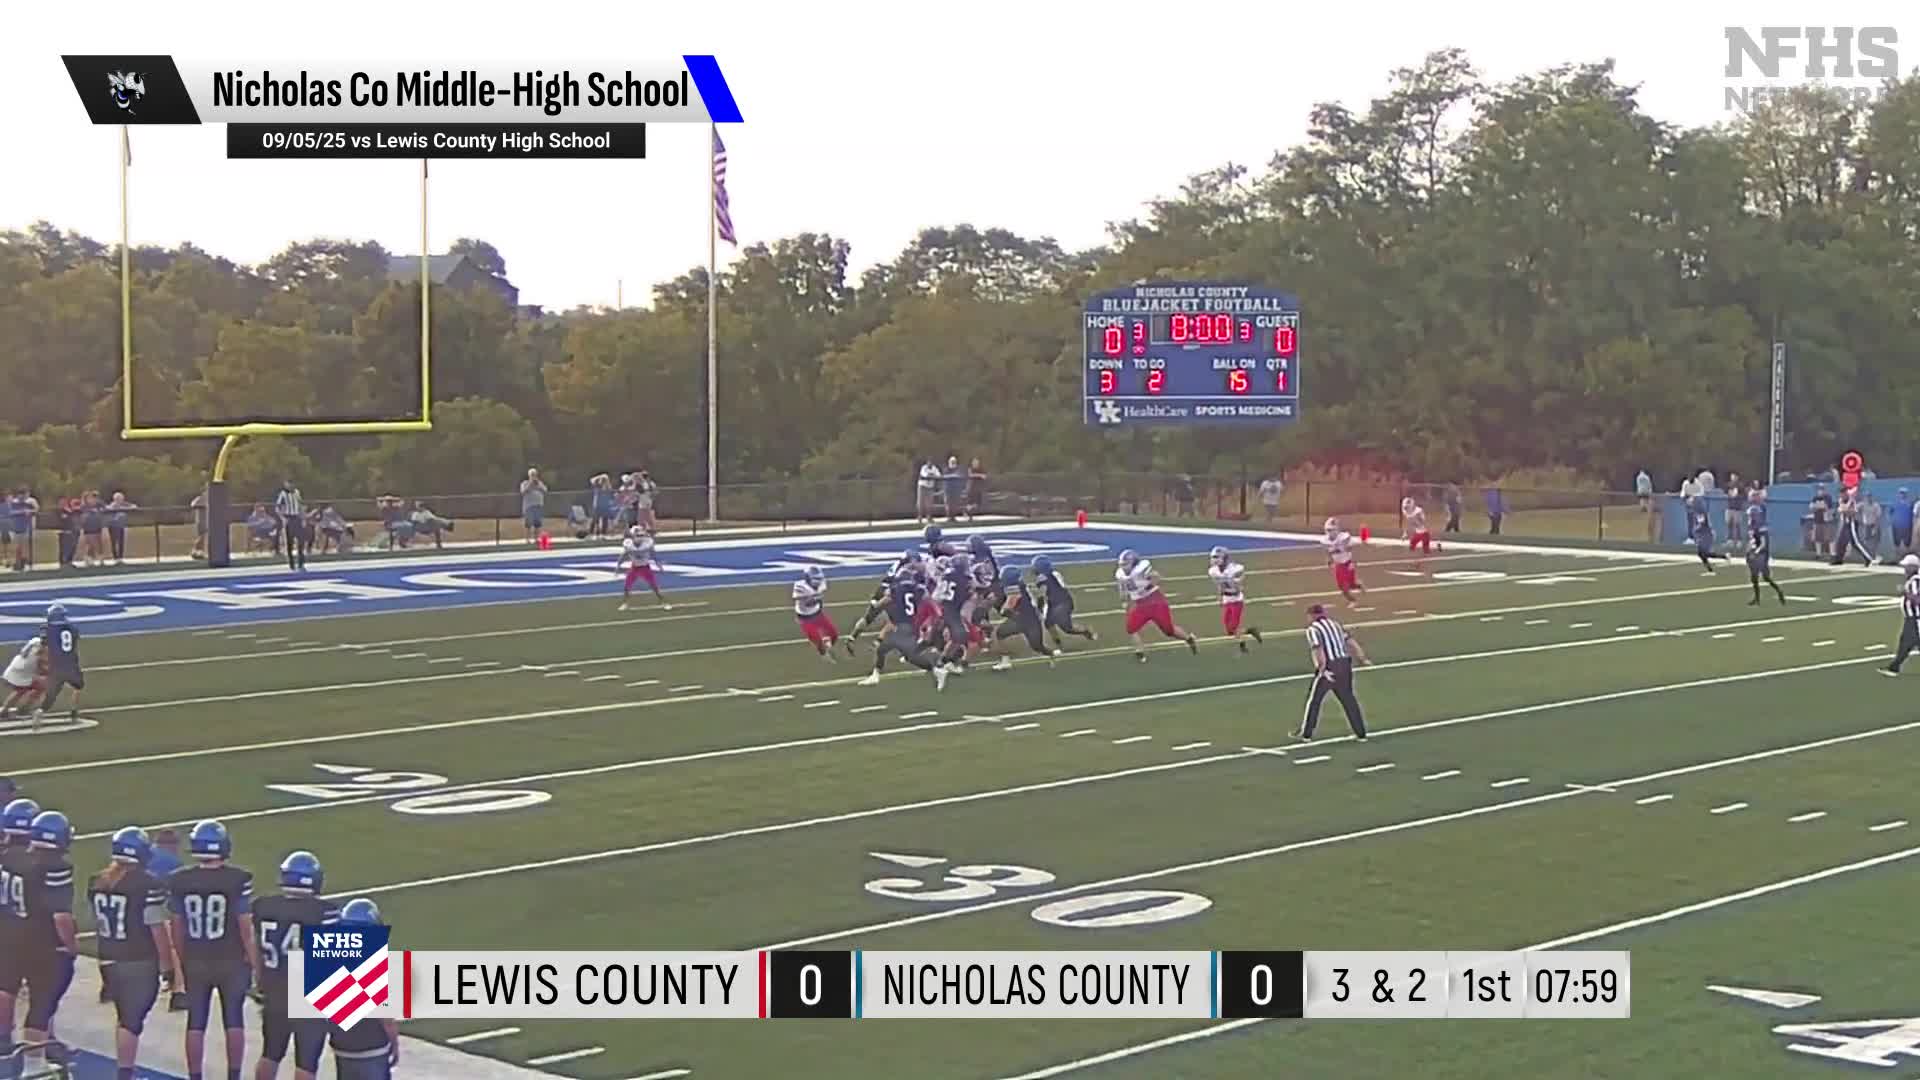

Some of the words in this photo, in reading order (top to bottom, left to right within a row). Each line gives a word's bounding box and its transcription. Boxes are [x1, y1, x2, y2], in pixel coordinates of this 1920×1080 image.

[1136, 287, 1195, 297] NICHOLAS
[1198, 287, 1248, 297] COUNTY
[1103, 299, 1199, 311] BLUEJACKET
[1204, 298, 1282, 311] FOOTBALL
[1087, 315, 1125, 328] HOME
[1171, 314, 1231, 341] 8:00
[1239, 321, 1251, 340] 3
[1255, 315, 1297, 328] GUEST
[1132, 322, 1144, 340] 3
[1275, 326, 1294, 354] 0
[1104, 327, 1122, 354] 0
[1089, 359, 1123, 370] DOWN
[1134, 359, 1148, 369] TO
[1149, 359, 1165, 369] GO
[1213, 358, 1238, 369] BALL
[1239, 358, 1256, 369] ON
[1265, 358, 1288, 371] QTR
[1100, 370, 1113, 392] 3
[1147, 370, 1162, 392] 2
[1229, 370, 1248, 391] 15
[1123, 404, 1188, 417] HealthCare
[1195, 405, 1237, 416] SPORTS
[1238, 405, 1292, 416] MEDICINE
[904, 592, 916, 617] 5
[94, 893, 127, 939] 67
[184, 894, 227, 940] 88
